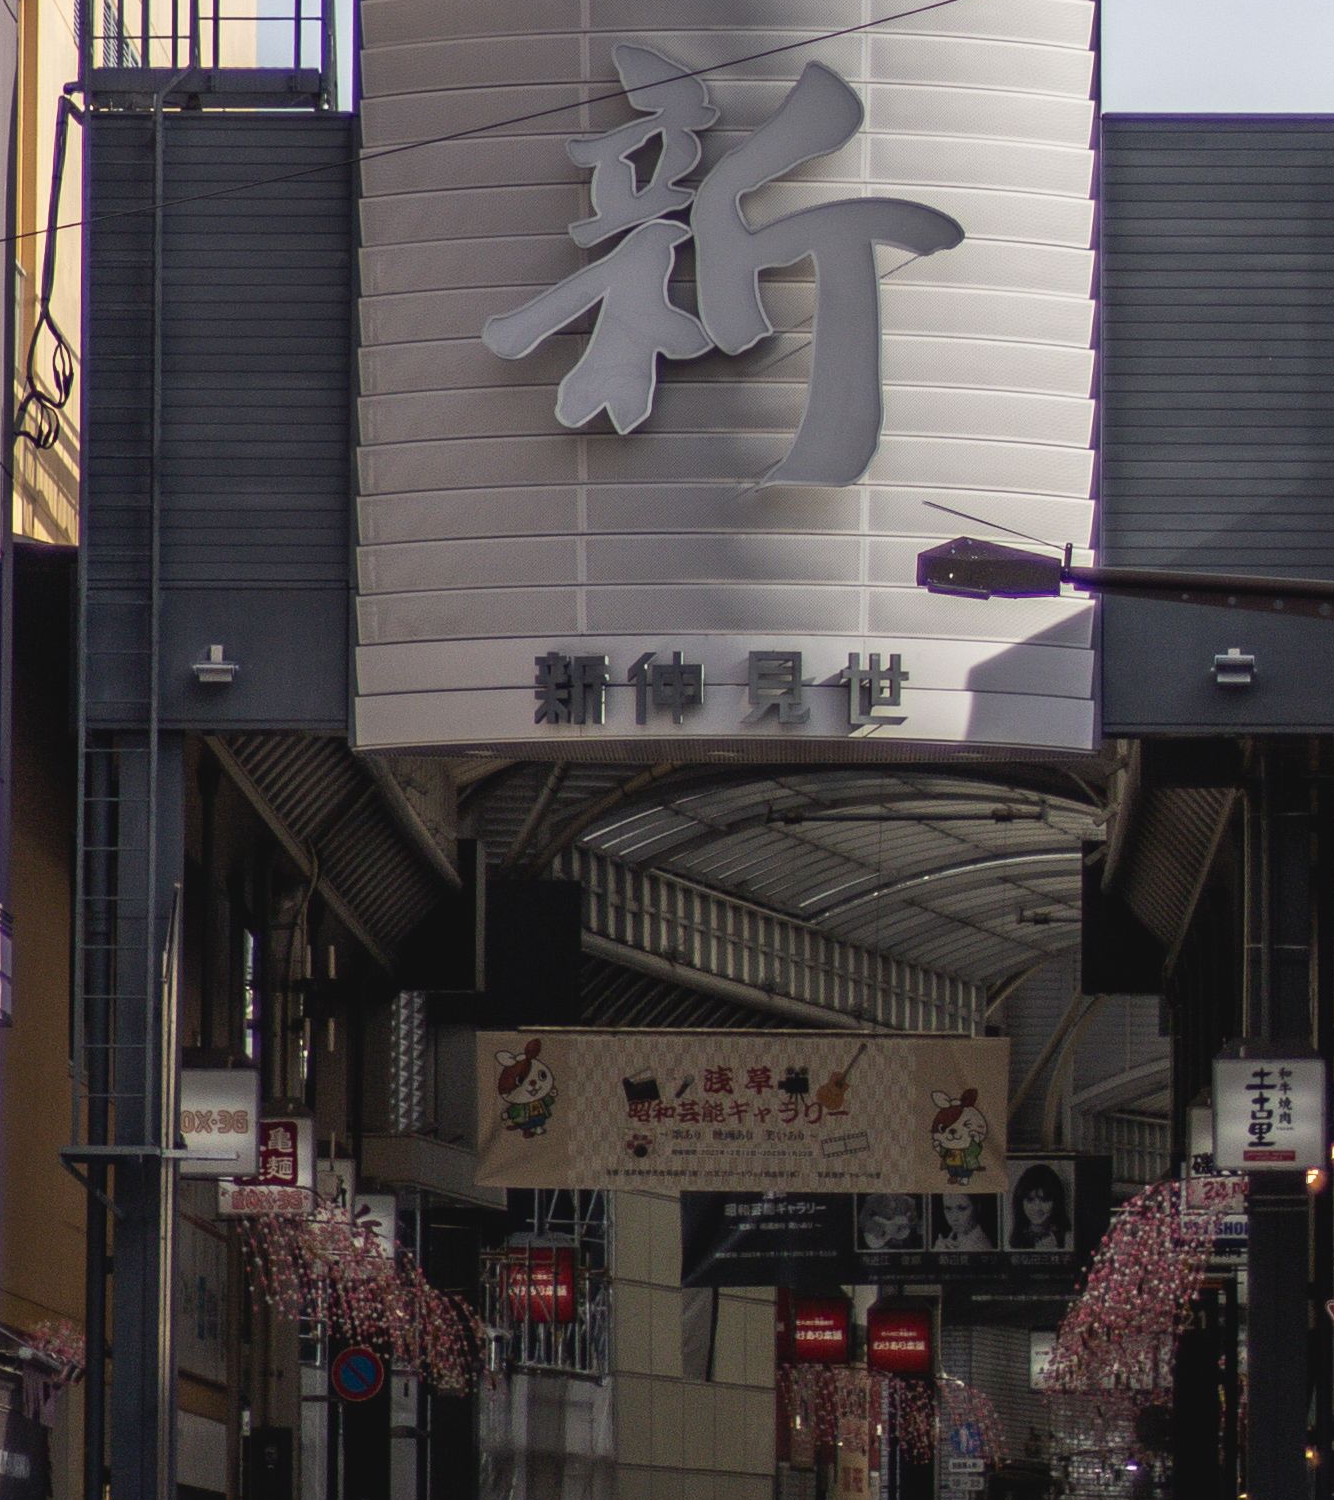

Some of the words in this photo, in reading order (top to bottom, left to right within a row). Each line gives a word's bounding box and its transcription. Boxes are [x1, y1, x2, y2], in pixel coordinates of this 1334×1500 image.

[482, 44, 964, 488] 新
[534, 650, 909, 727] 新仲見世
[628, 1099, 849, 1125] 昭和芸能ギャラリー
[703, 1067, 774, 1095] 浅草
[1244, 1067, 1277, 1148] 土古里
[1278, 1067, 1293, 1125] 和牛焼肉
